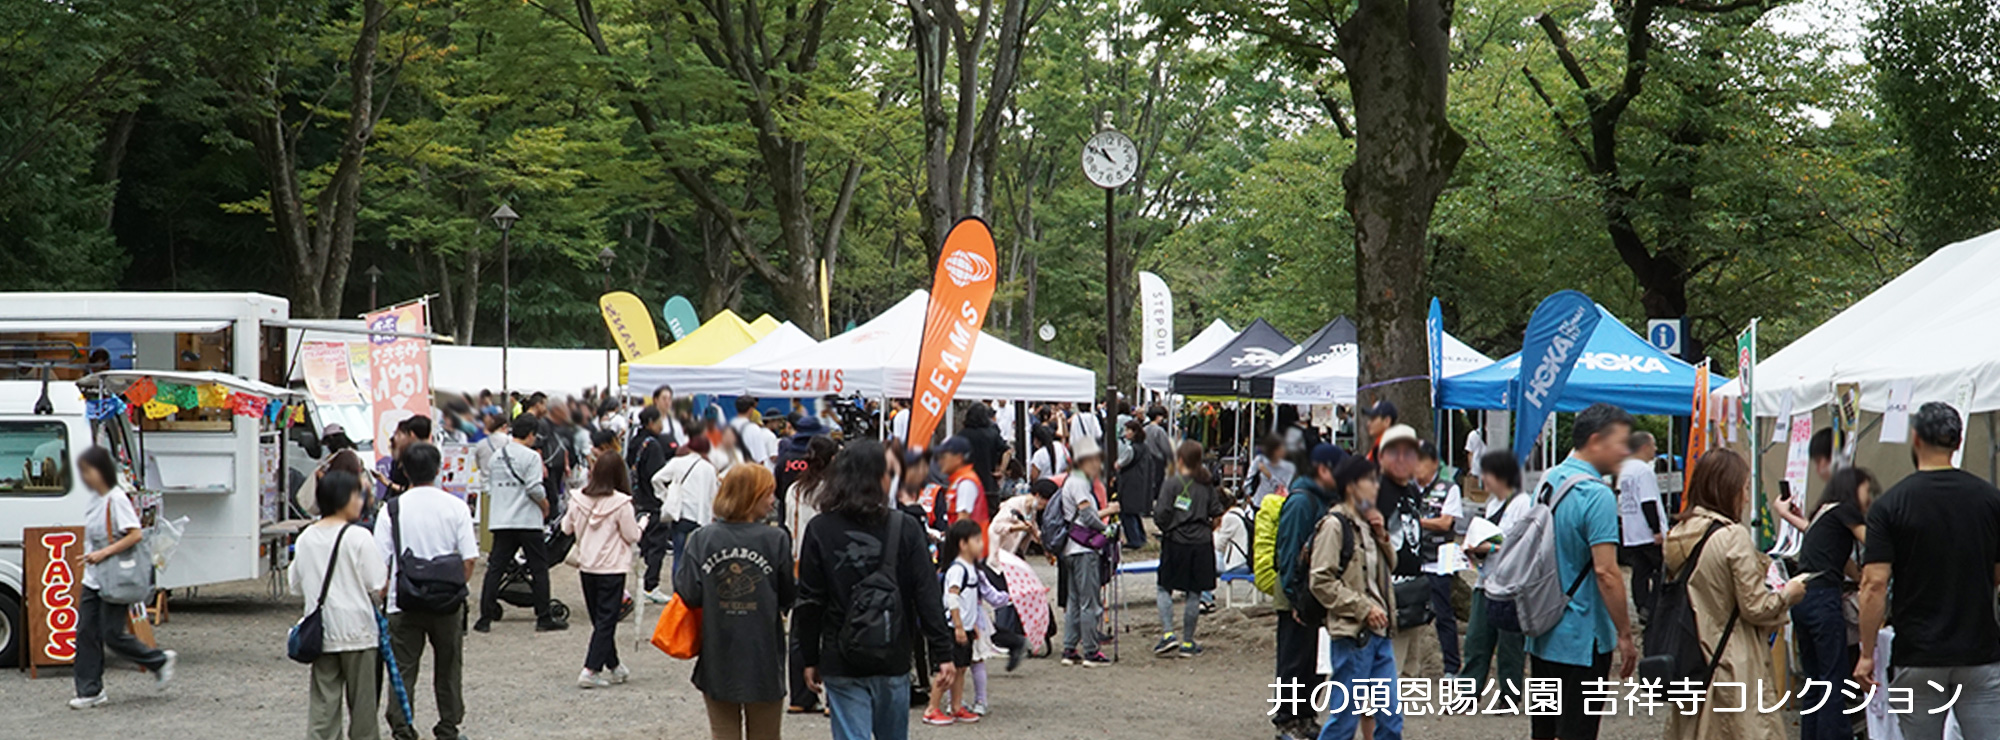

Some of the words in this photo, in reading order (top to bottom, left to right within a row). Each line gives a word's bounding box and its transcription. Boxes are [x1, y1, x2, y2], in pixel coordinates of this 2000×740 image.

[1152, 292, 1168, 356] STEPOUT
[779, 368, 844, 393] BEAMS
[920, 299, 979, 417] BEAMS
[1524, 335, 1575, 409] HOKA
[1574, 352, 1670, 374] HOKA
[701, 547, 773, 574] BILLABONG
[42, 532, 79, 660] TACOS
